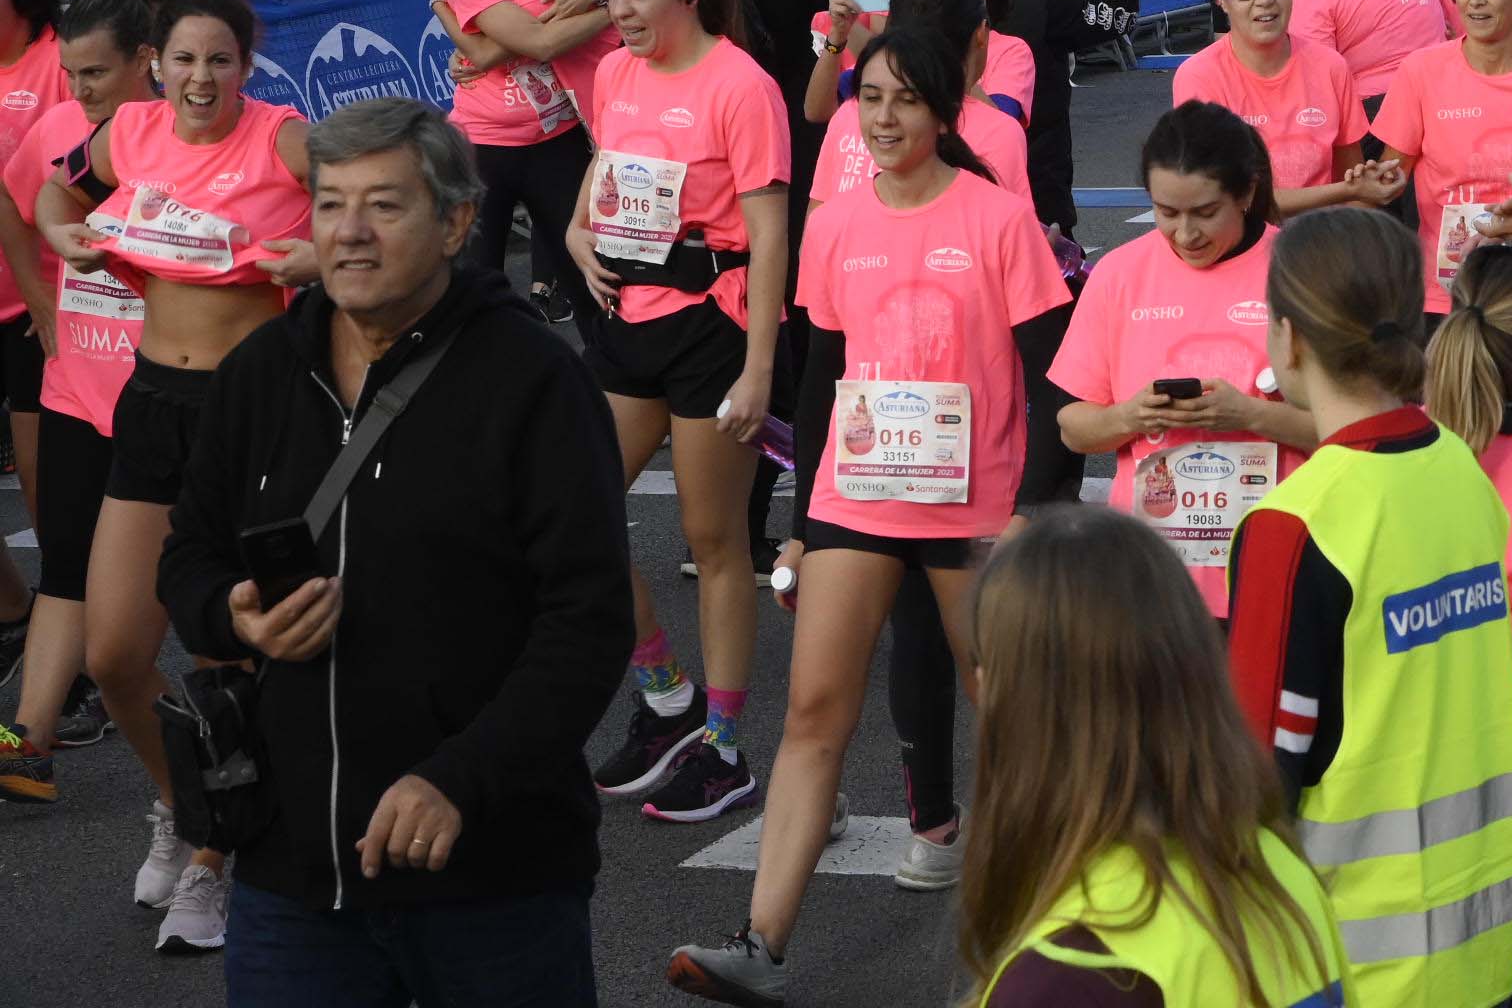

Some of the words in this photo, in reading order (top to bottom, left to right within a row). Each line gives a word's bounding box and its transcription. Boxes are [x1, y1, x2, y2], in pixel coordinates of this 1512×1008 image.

[1437, 107, 1482, 121] OYSHO
[844, 154, 864, 175] DE
[621, 195, 651, 213] 016
[843, 254, 888, 273] OYSHO
[71, 295, 104, 310] OYSHO
[1131, 305, 1185, 322] OYSHO
[69, 321, 136, 353] SUMA
[878, 402, 926, 413] ASTURIANA
[879, 429, 922, 446] 016
[882, 451, 916, 462] 33151
[1239, 458, 1266, 467] SUMA
[849, 466, 885, 474] CARRERA
[897, 467, 907, 475] LA
[907, 468, 935, 476] MUJER
[1179, 461, 1231, 475] ASTURIANA
[846, 482, 886, 493] OYSHO
[1181, 491, 1229, 509] 016
[1185, 514, 1222, 526] 19083
[1188, 530, 1199, 538] DE
[1201, 530, 1212, 538] LA
[1388, 577, 1505, 638] VOLUNTARIS
